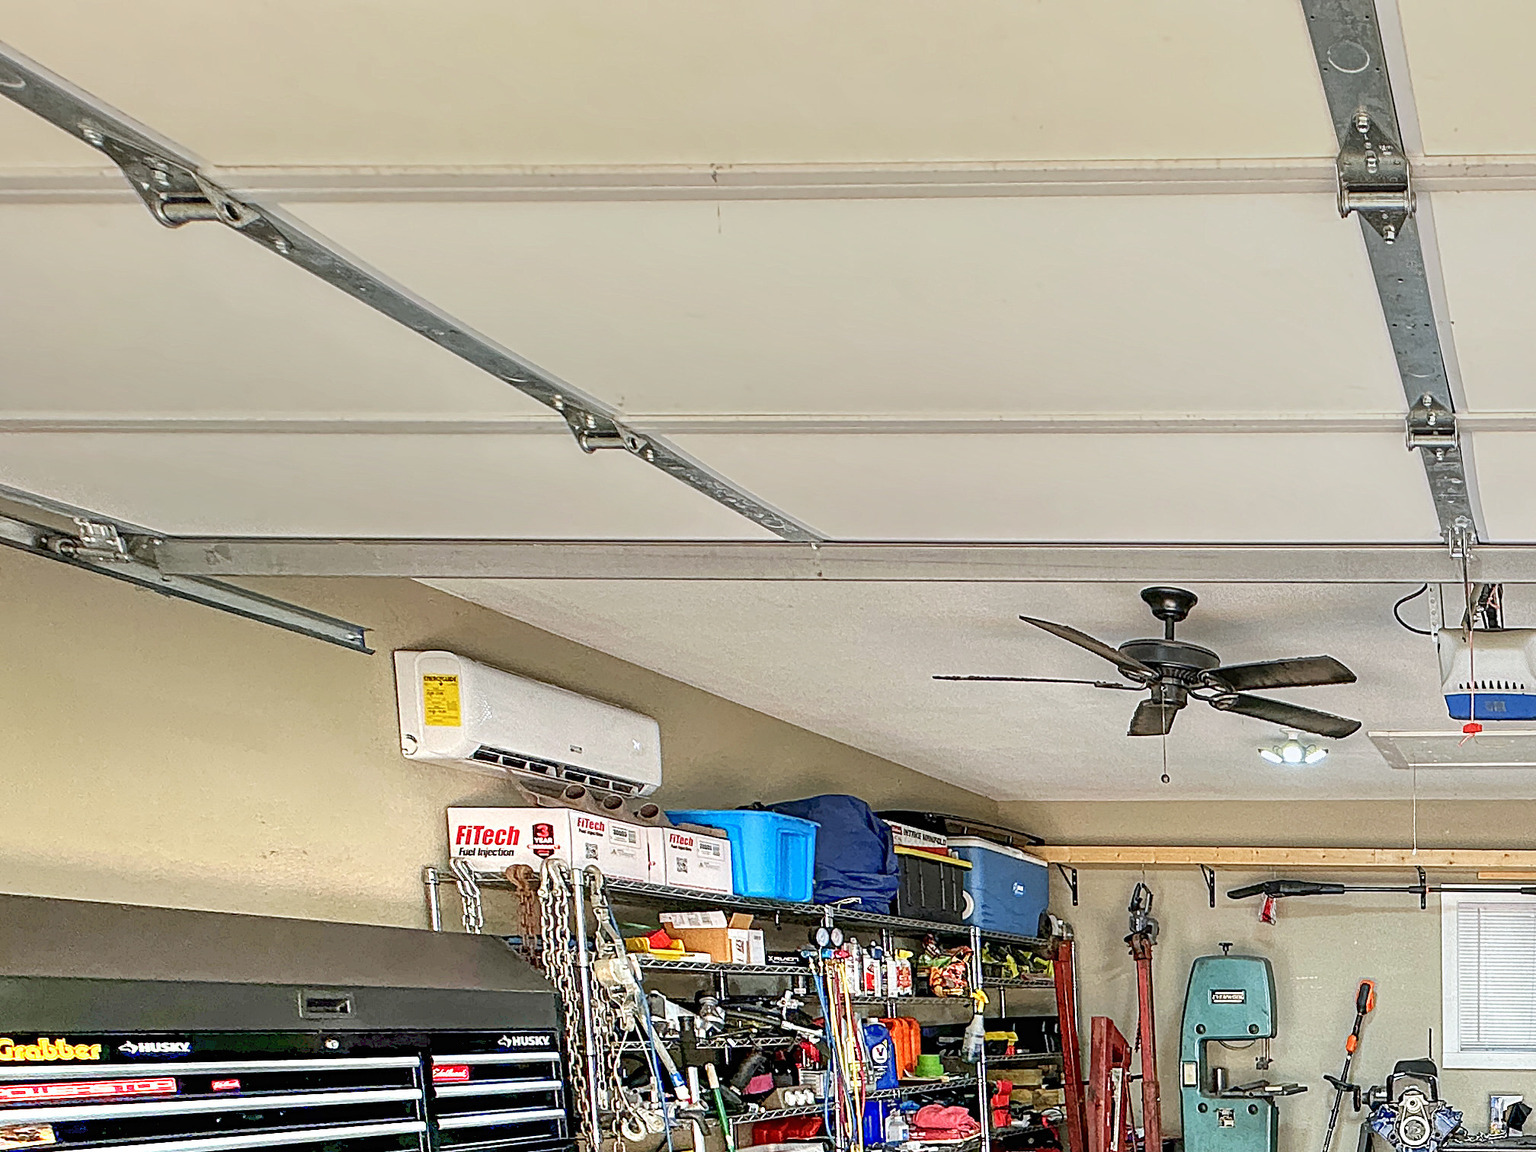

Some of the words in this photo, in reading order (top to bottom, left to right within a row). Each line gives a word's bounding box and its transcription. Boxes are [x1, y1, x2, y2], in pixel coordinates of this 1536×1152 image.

[536, 824, 549, 838] 3
[577, 817, 605, 832] FiTech
[455, 825, 520, 846] FiTech
[669, 833, 694, 847] FiTech
[459, 847, 476, 856] Fuel
[478, 847, 515, 858] Injection
[138, 1042, 191, 1053] HUSKY
[512, 1035, 550, 1046] HUSKY
[0, 1037, 102, 1061] Grabber
